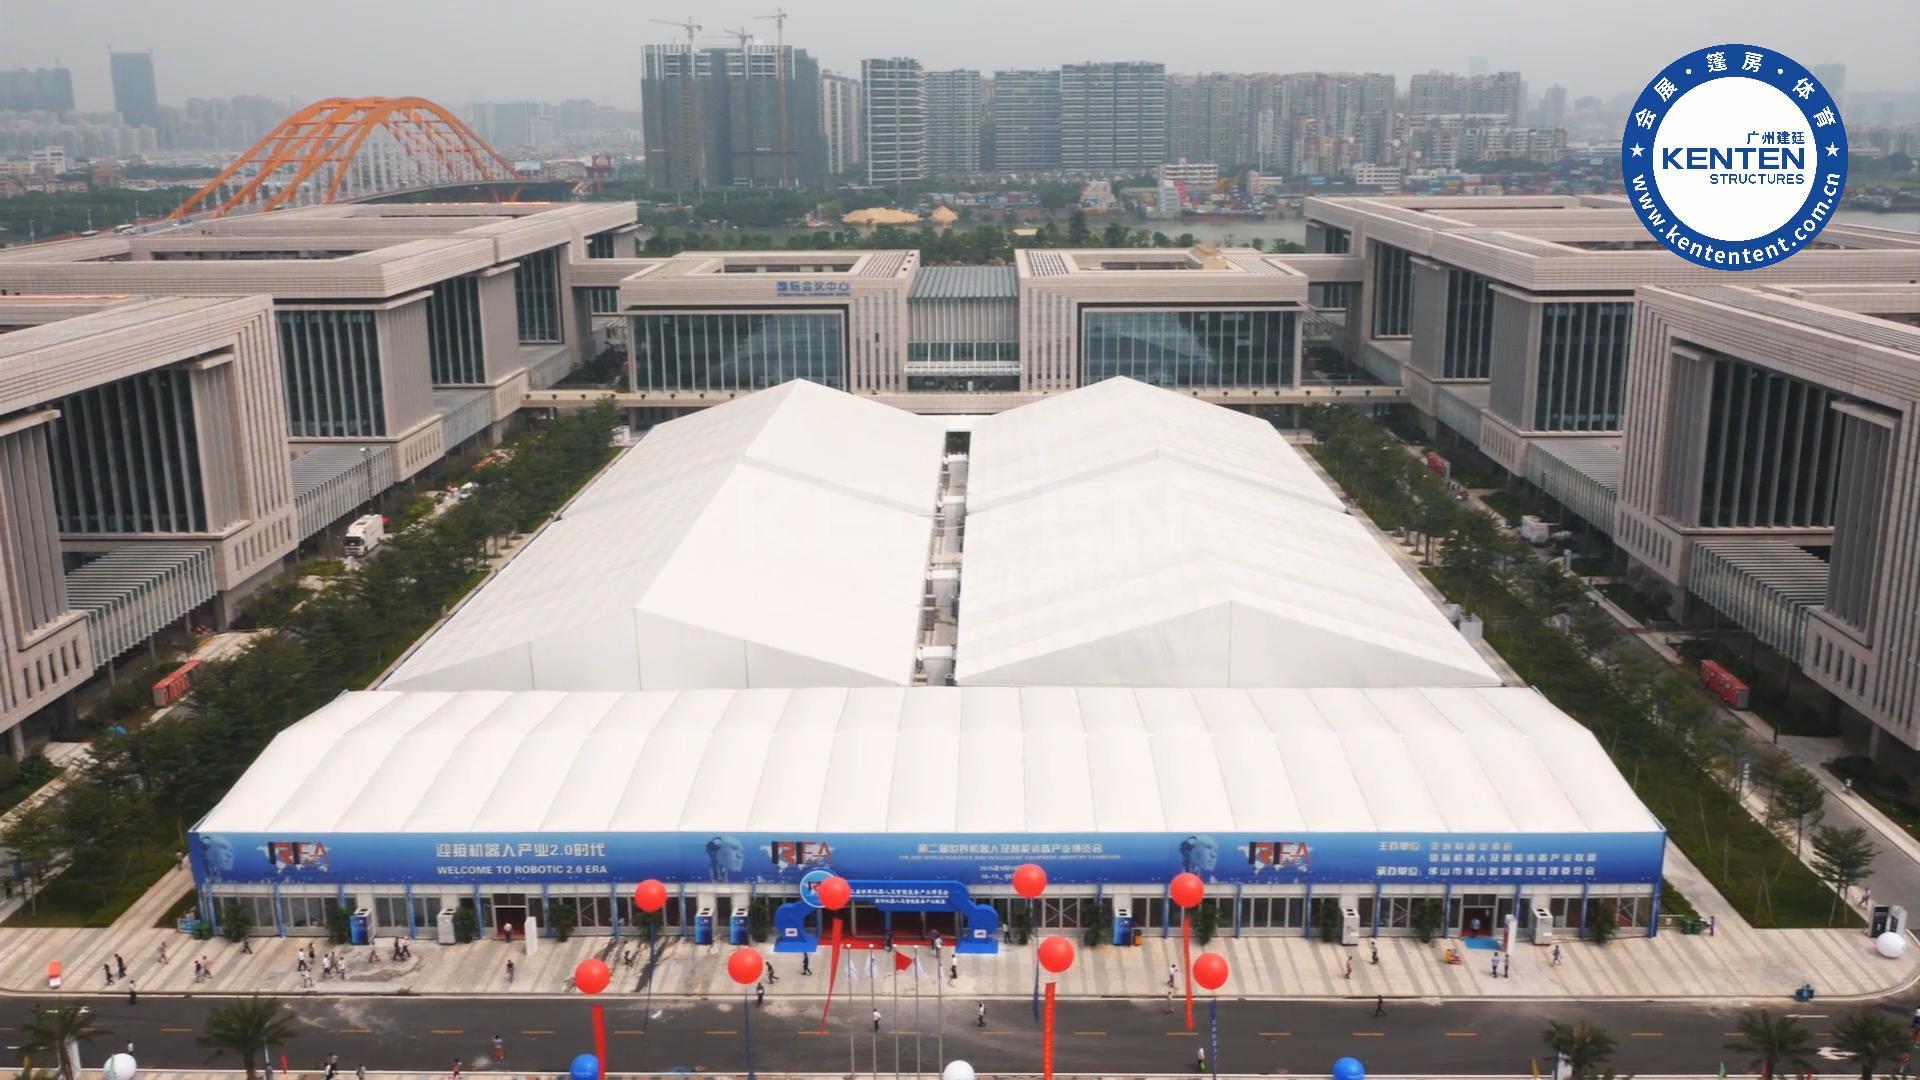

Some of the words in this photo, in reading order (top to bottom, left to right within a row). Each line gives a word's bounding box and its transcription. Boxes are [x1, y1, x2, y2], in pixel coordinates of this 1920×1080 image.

[437, 866, 493, 875] WELCOME
[496, 866, 511, 875] TO
[514, 865, 564, 874] ROBOTIC
[566, 865, 583, 874] 2.0
[585, 865, 607, 874] ERA
